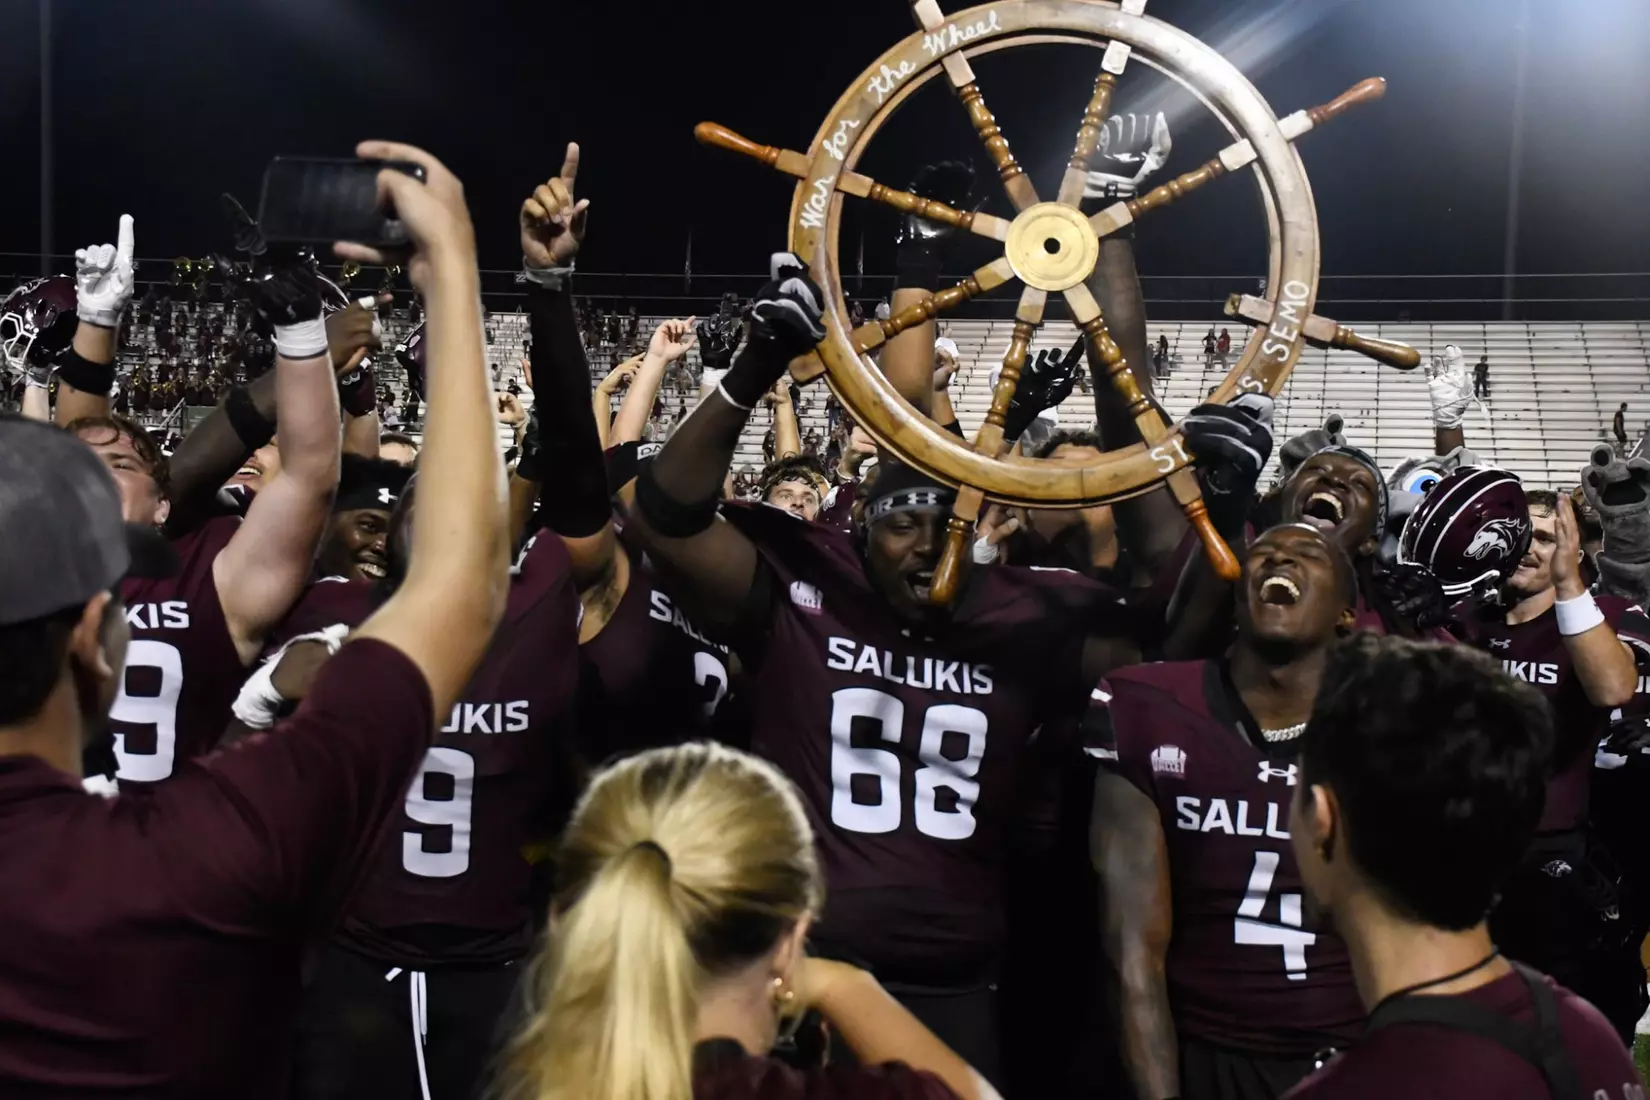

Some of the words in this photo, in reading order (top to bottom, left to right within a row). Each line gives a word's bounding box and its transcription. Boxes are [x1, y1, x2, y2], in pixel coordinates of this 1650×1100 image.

[800, 175, 834, 229] War
[823, 117, 860, 161] for
[867, 60, 916, 103] the
[922, 9, 1001, 56] Wheel
[1262, 280, 1310, 362] SEMO
[110, 639, 184, 782] 9
[827, 636, 994, 694] SALUKIS
[403, 746, 475, 878] 9
[830, 687, 989, 841] 68
[1234, 850, 1316, 981] 4
